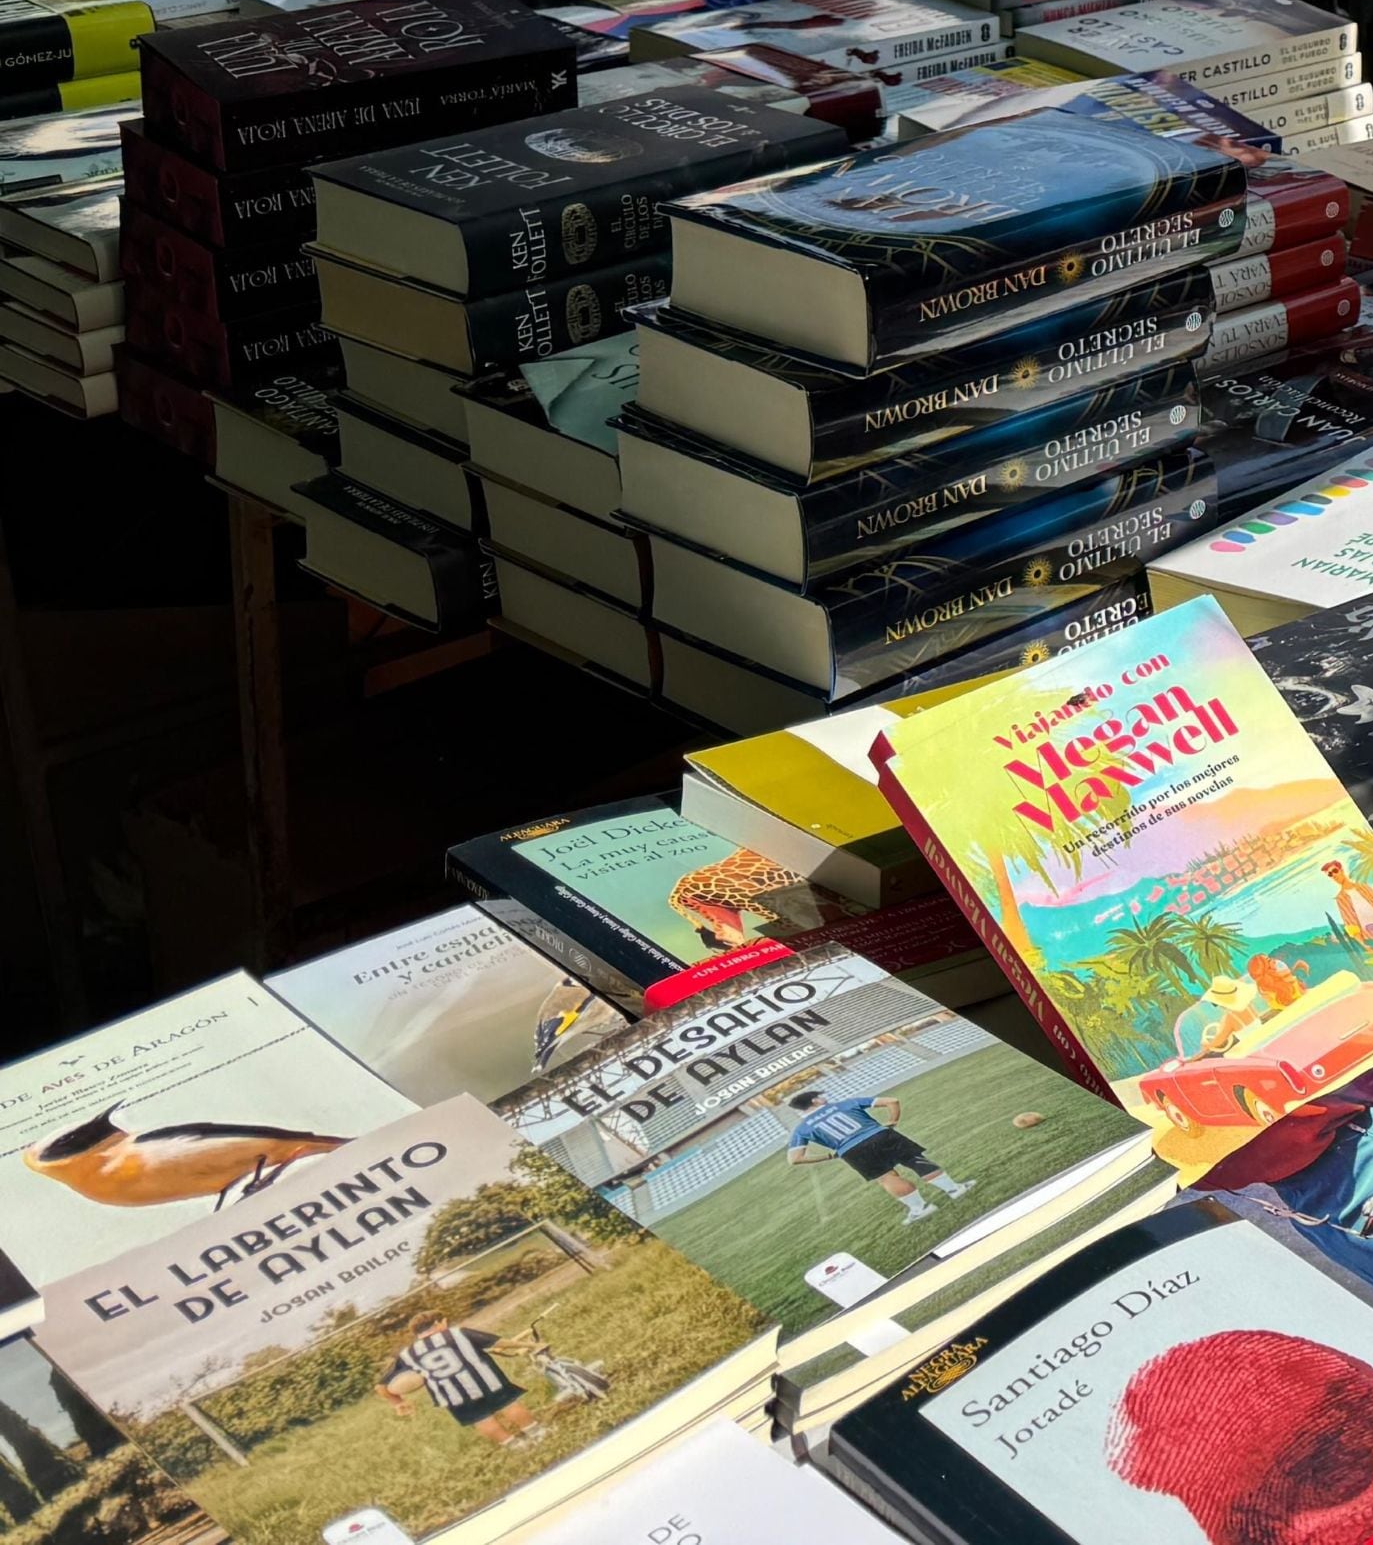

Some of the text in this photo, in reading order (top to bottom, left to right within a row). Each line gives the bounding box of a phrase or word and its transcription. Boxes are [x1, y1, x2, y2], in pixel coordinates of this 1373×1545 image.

[894, 30, 974, 60] FREIDA McFADDEN
[1202, 36, 1332, 79] CASTILLO SUSURRO
[1301, 45, 1330, 63] FUEGO
[237, 119, 287, 146] ROJA
[420, 142, 574, 191] FOLLETT
[511, 230, 529, 271] KEN
[1100, 211, 1195, 255] SECRETO
[1091, 237, 1173, 278] ÚLTIMO
[918, 264, 1048, 323] DAN BROWN
[518, 313, 535, 353] KEN
[1058, 315, 1159, 361] SECRETO
[864, 390, 947, 433] BROWN
[1215, 377, 1302, 419] CARLOS
[883, 575, 1014, 645] DAN BROWN
[992, 653, 1172, 751] Viajando con
[1085, 753, 1241, 845] recorrido mejores
[1091, 774, 1235, 858] destinos novelas
[539, 814, 694, 863] Joël Dicke
[577, 841, 710, 881] visita zoo
[597, 841, 650, 867] muy
[352, 951, 429, 986] Entre
[720, 951, 758, 976] LIBRO
[41, 1070, 86, 1095] AVES
[132, 1009, 229, 1057] ARAGÓN
[562, 978, 820, 1119] EL DESAFÍO
[619, 1008, 833, 1125] DE AYLAN
[83, 1140, 449, 1323] EL LABERINTO
[172, 1185, 433, 1325] DE AYLAN
[259, 1280, 336, 1324] JOSAN
[960, 1269, 1201, 1429] Santiago Díaz
[993, 1378, 1095, 1461] Jotadé
